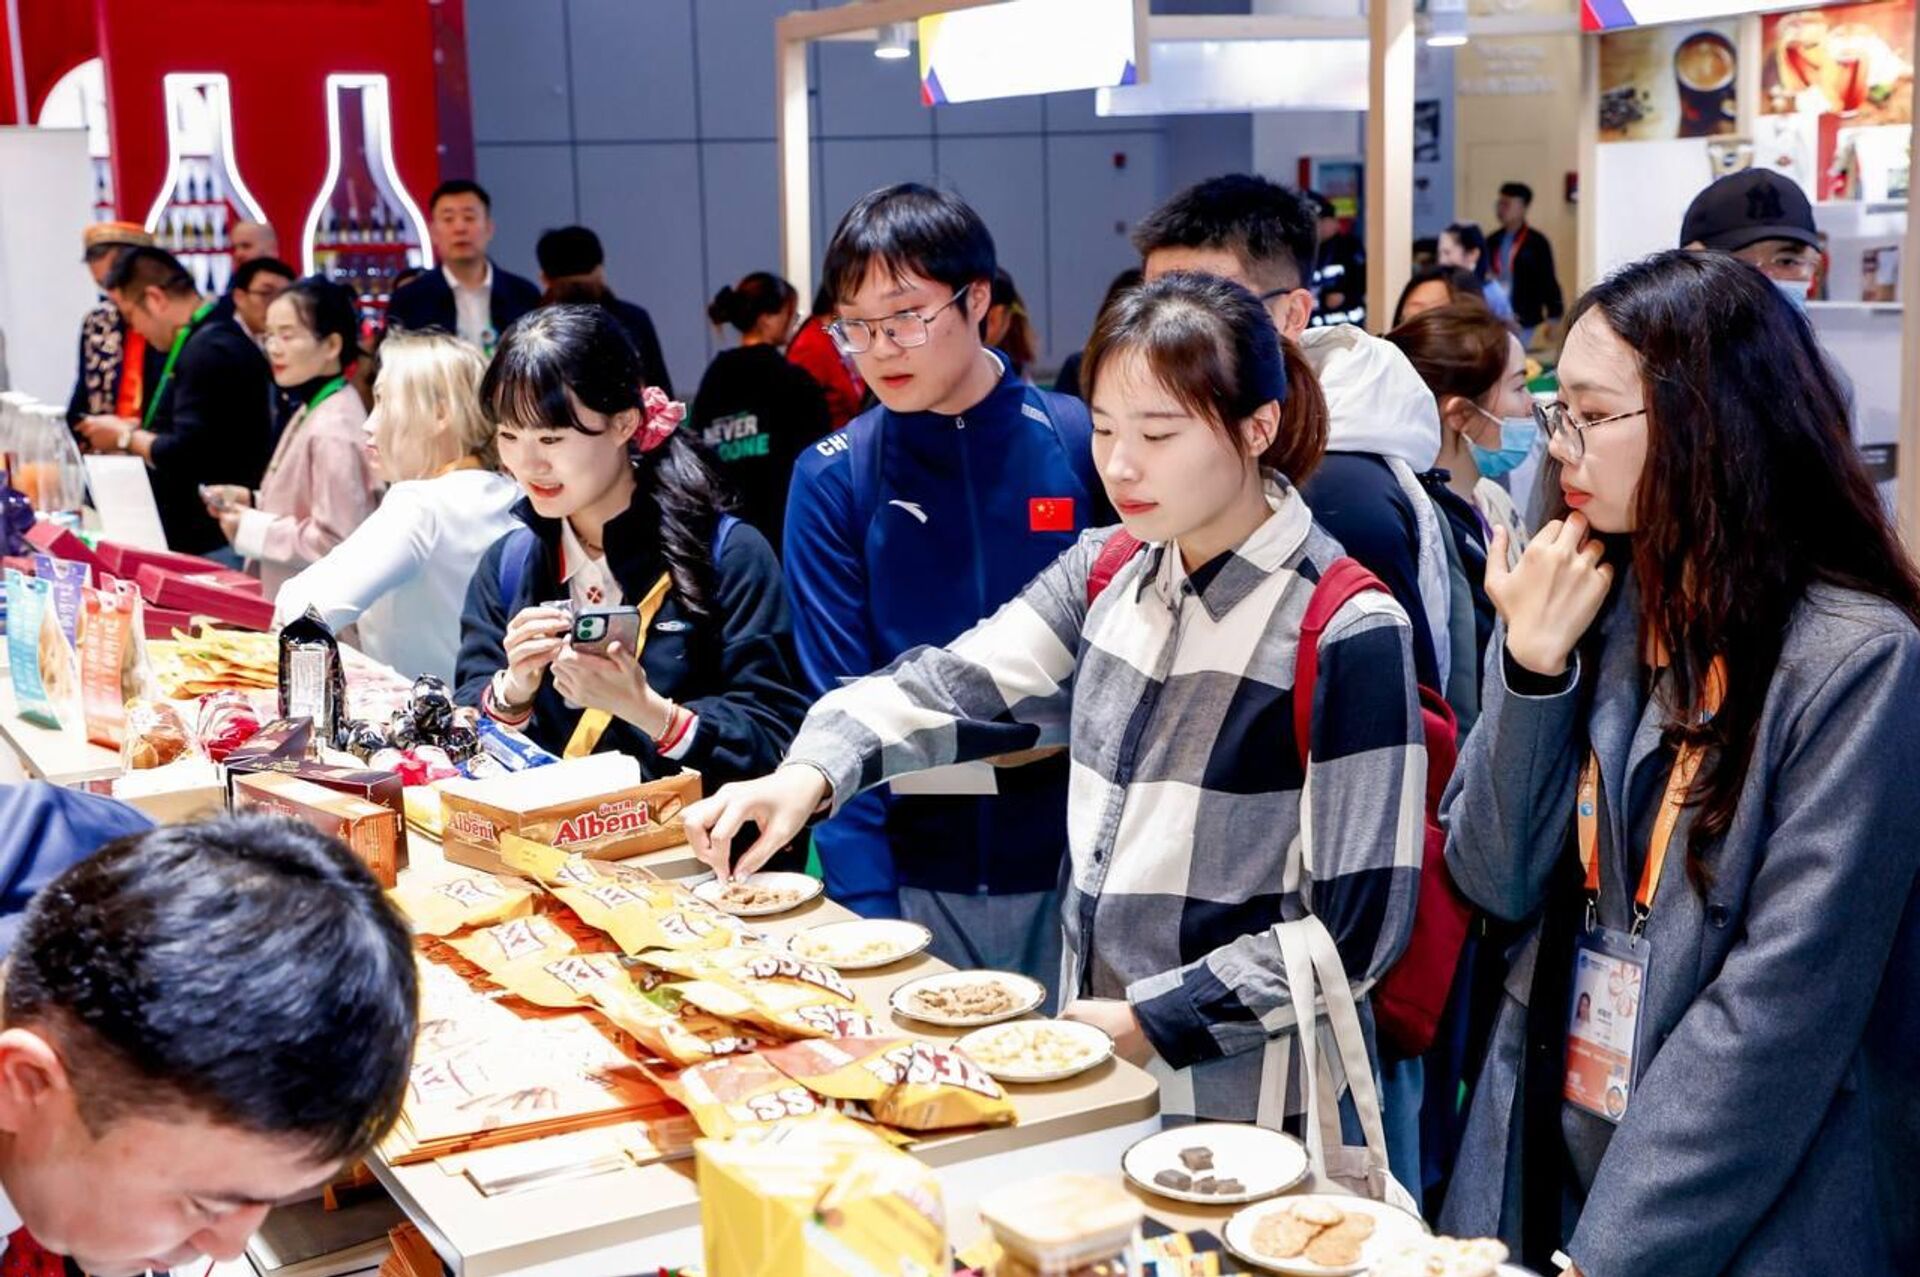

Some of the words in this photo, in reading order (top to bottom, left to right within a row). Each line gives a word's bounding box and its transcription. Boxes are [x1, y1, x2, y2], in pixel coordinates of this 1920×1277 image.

[703, 414, 758, 445] NEVER
[448, 811, 494, 841] Albeni
[552, 801, 649, 846] Albeni
